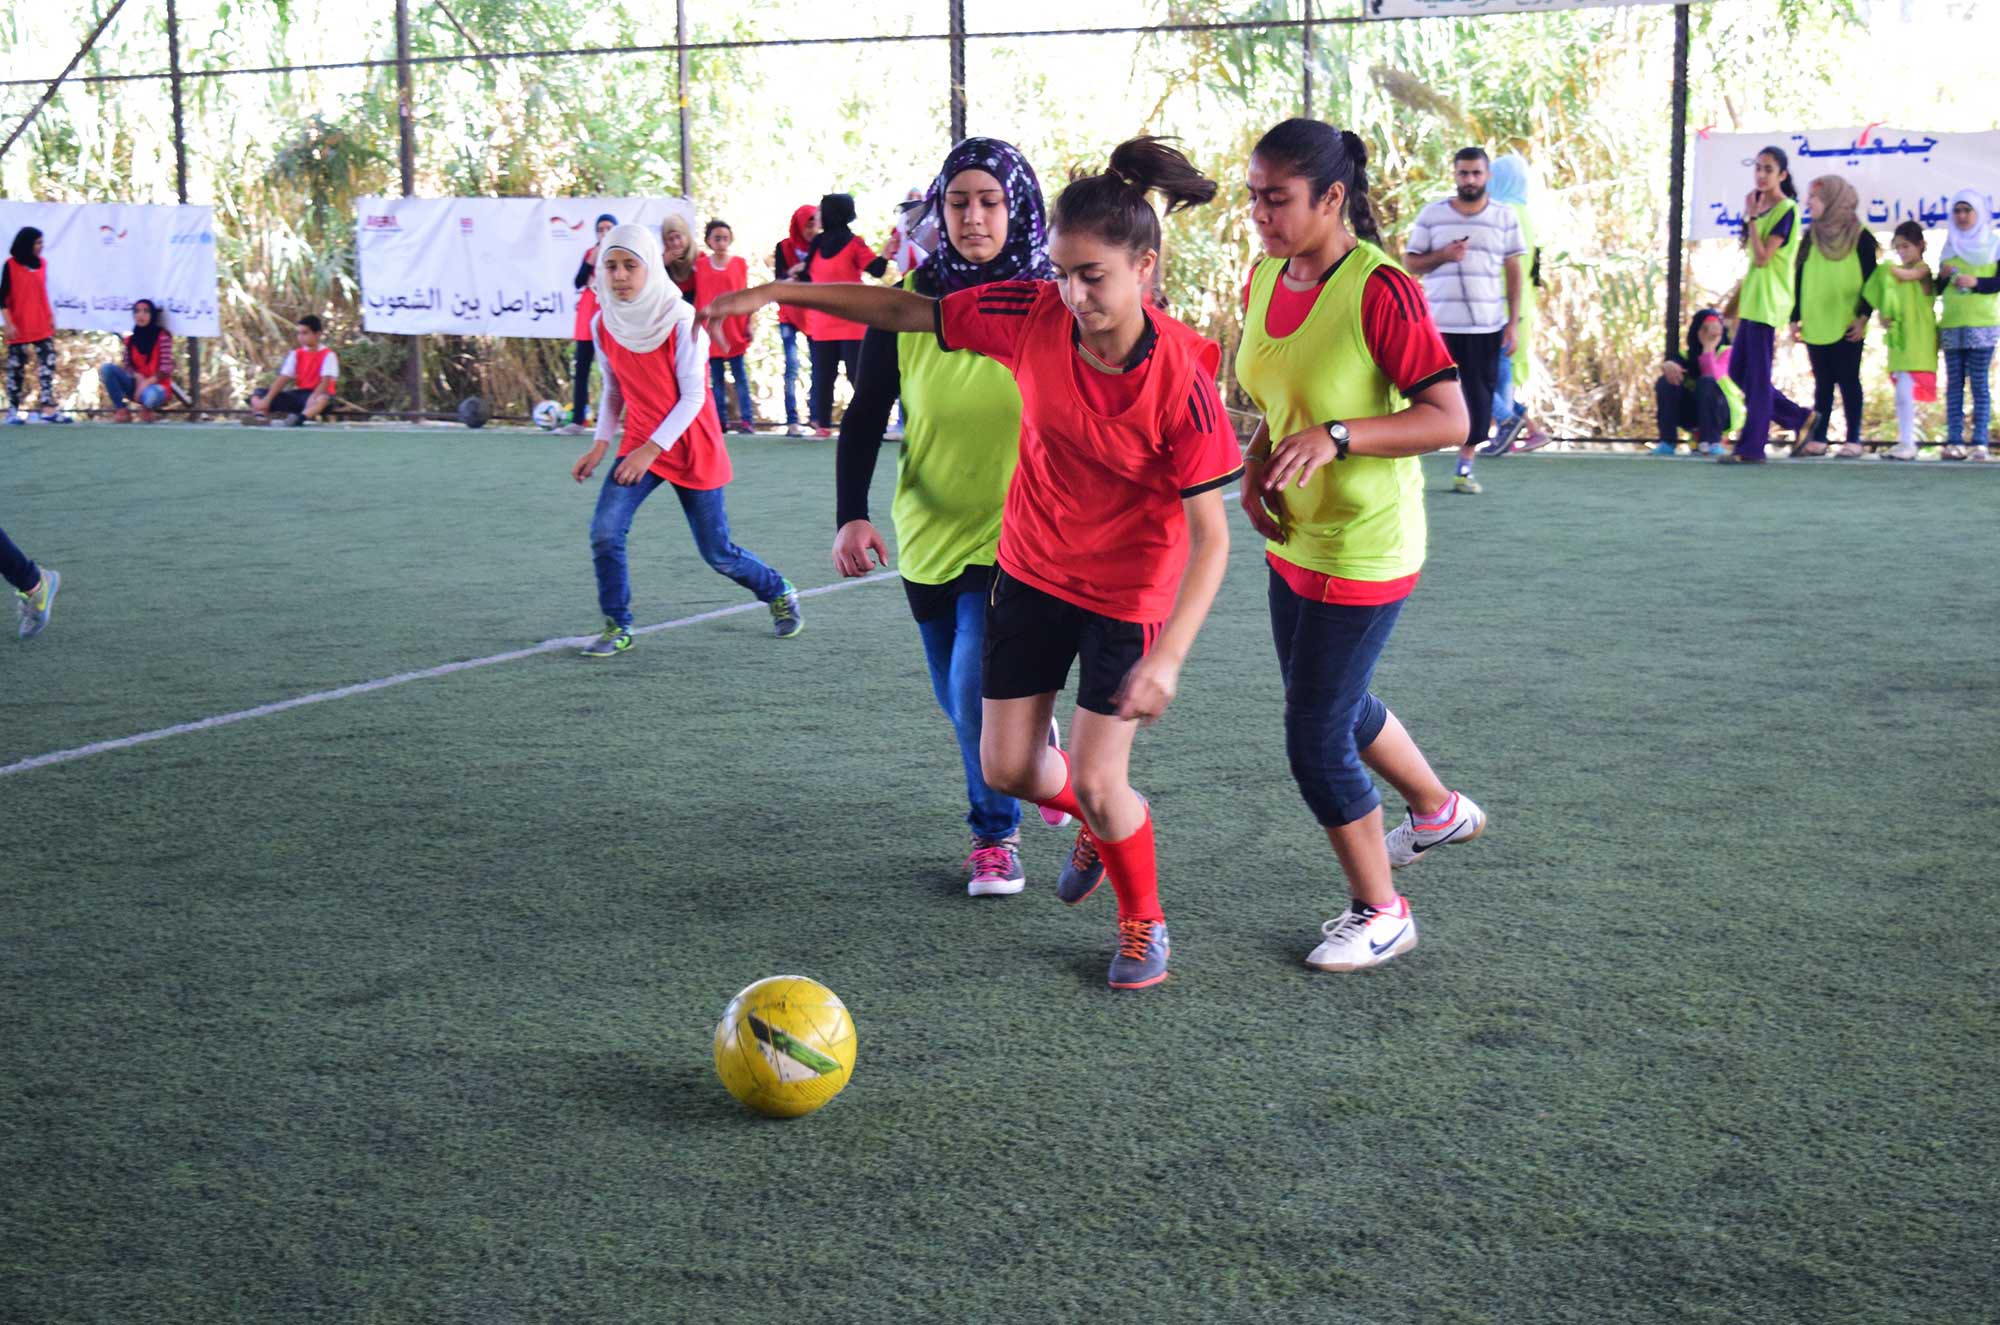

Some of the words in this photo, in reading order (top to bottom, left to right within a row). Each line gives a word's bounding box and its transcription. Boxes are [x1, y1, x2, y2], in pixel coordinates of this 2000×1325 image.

[1791, 134, 1938, 165] جمعية
[368, 287, 442, 316] الشعوب
[451, 293, 481, 320] بين
[490, 289, 564, 321] التواصل
